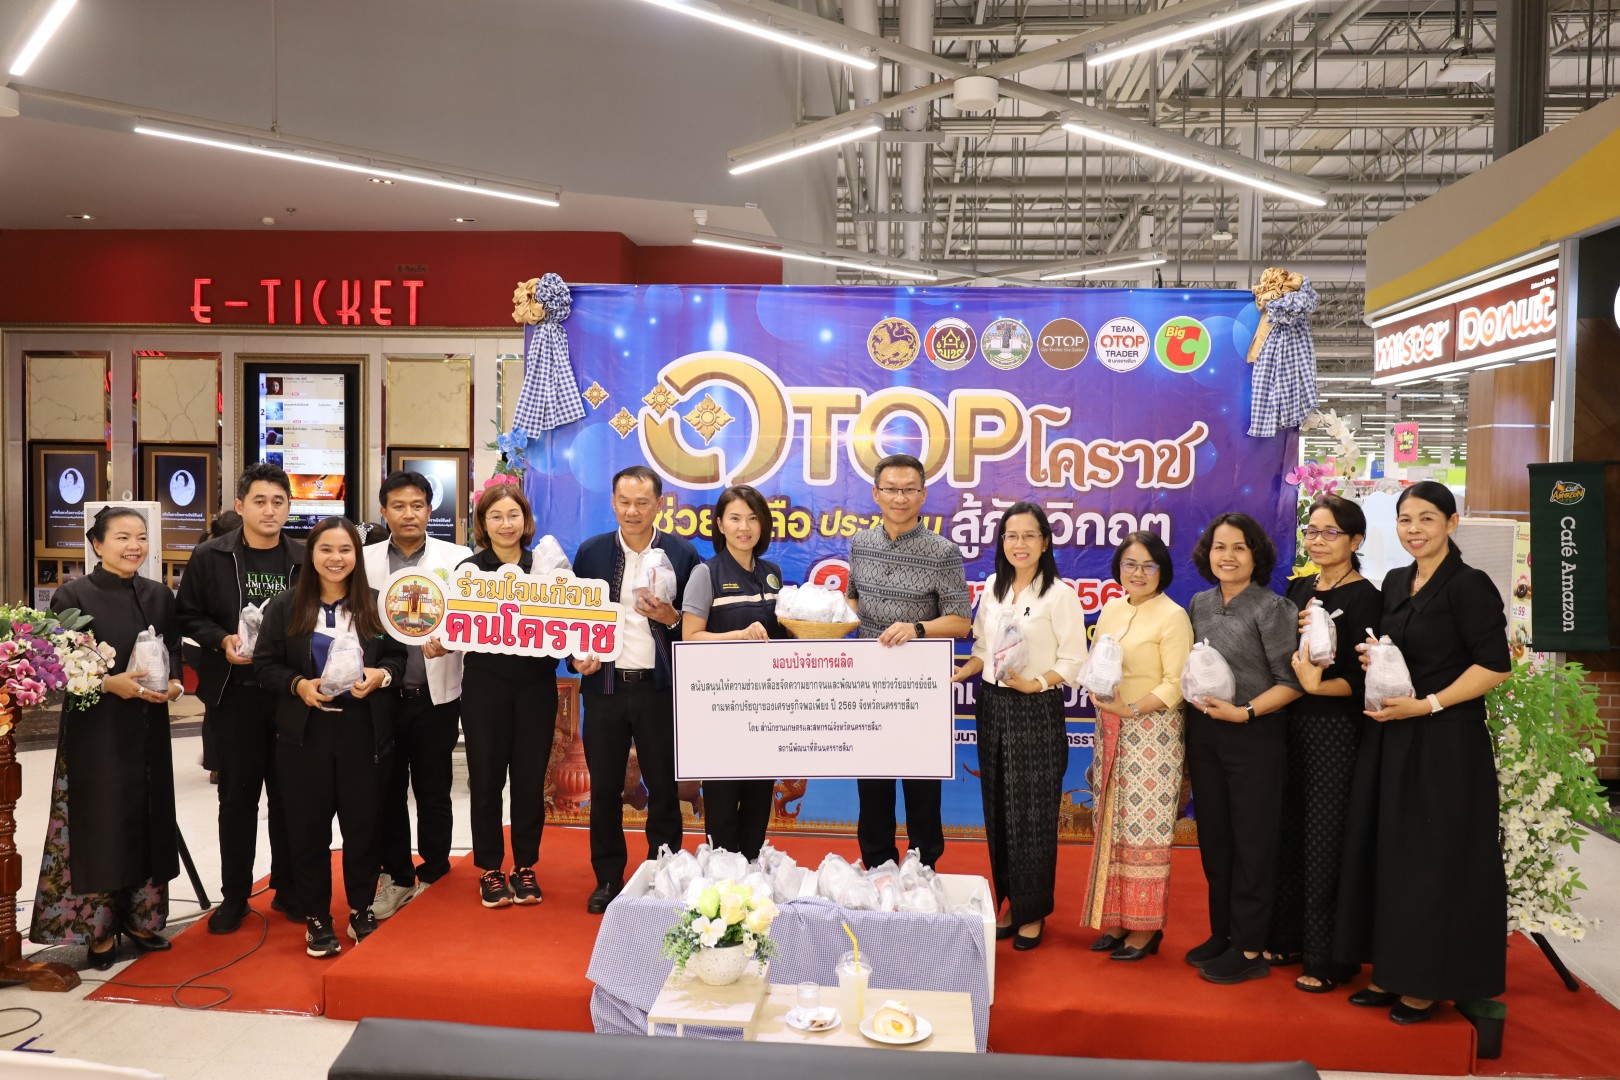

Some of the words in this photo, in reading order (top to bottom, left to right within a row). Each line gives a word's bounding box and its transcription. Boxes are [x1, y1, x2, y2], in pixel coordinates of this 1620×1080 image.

[1111, 325, 1135, 333] TEAM
[1165, 326, 1186, 339] Big
[1458, 287, 1556, 352] Donut
[1042, 335, 1084, 347] OTOP
[1100, 335, 1145, 348] OTOP
[1105, 350, 1139, 358] TRADER
[1166, 326, 1201, 366] C
[641, 354, 1026, 489] OTOP
[1028, 406, 1208, 490] โคราช
[1560, 516, 1578, 557] Café
[456, 571, 602, 607] ร่วมใจแก้จน
[1561, 561, 1577, 632] Amazon
[445, 603, 616, 654] คนโคราช
[772, 652, 854, 670] มอบปัจจัยการผลิต
[830, 698, 836, 711] ปี
[838, 700, 857, 711] 2569
[858, 698, 919, 711] จังหวัดนครราชสีมา
[748, 722, 759, 732] โดย
